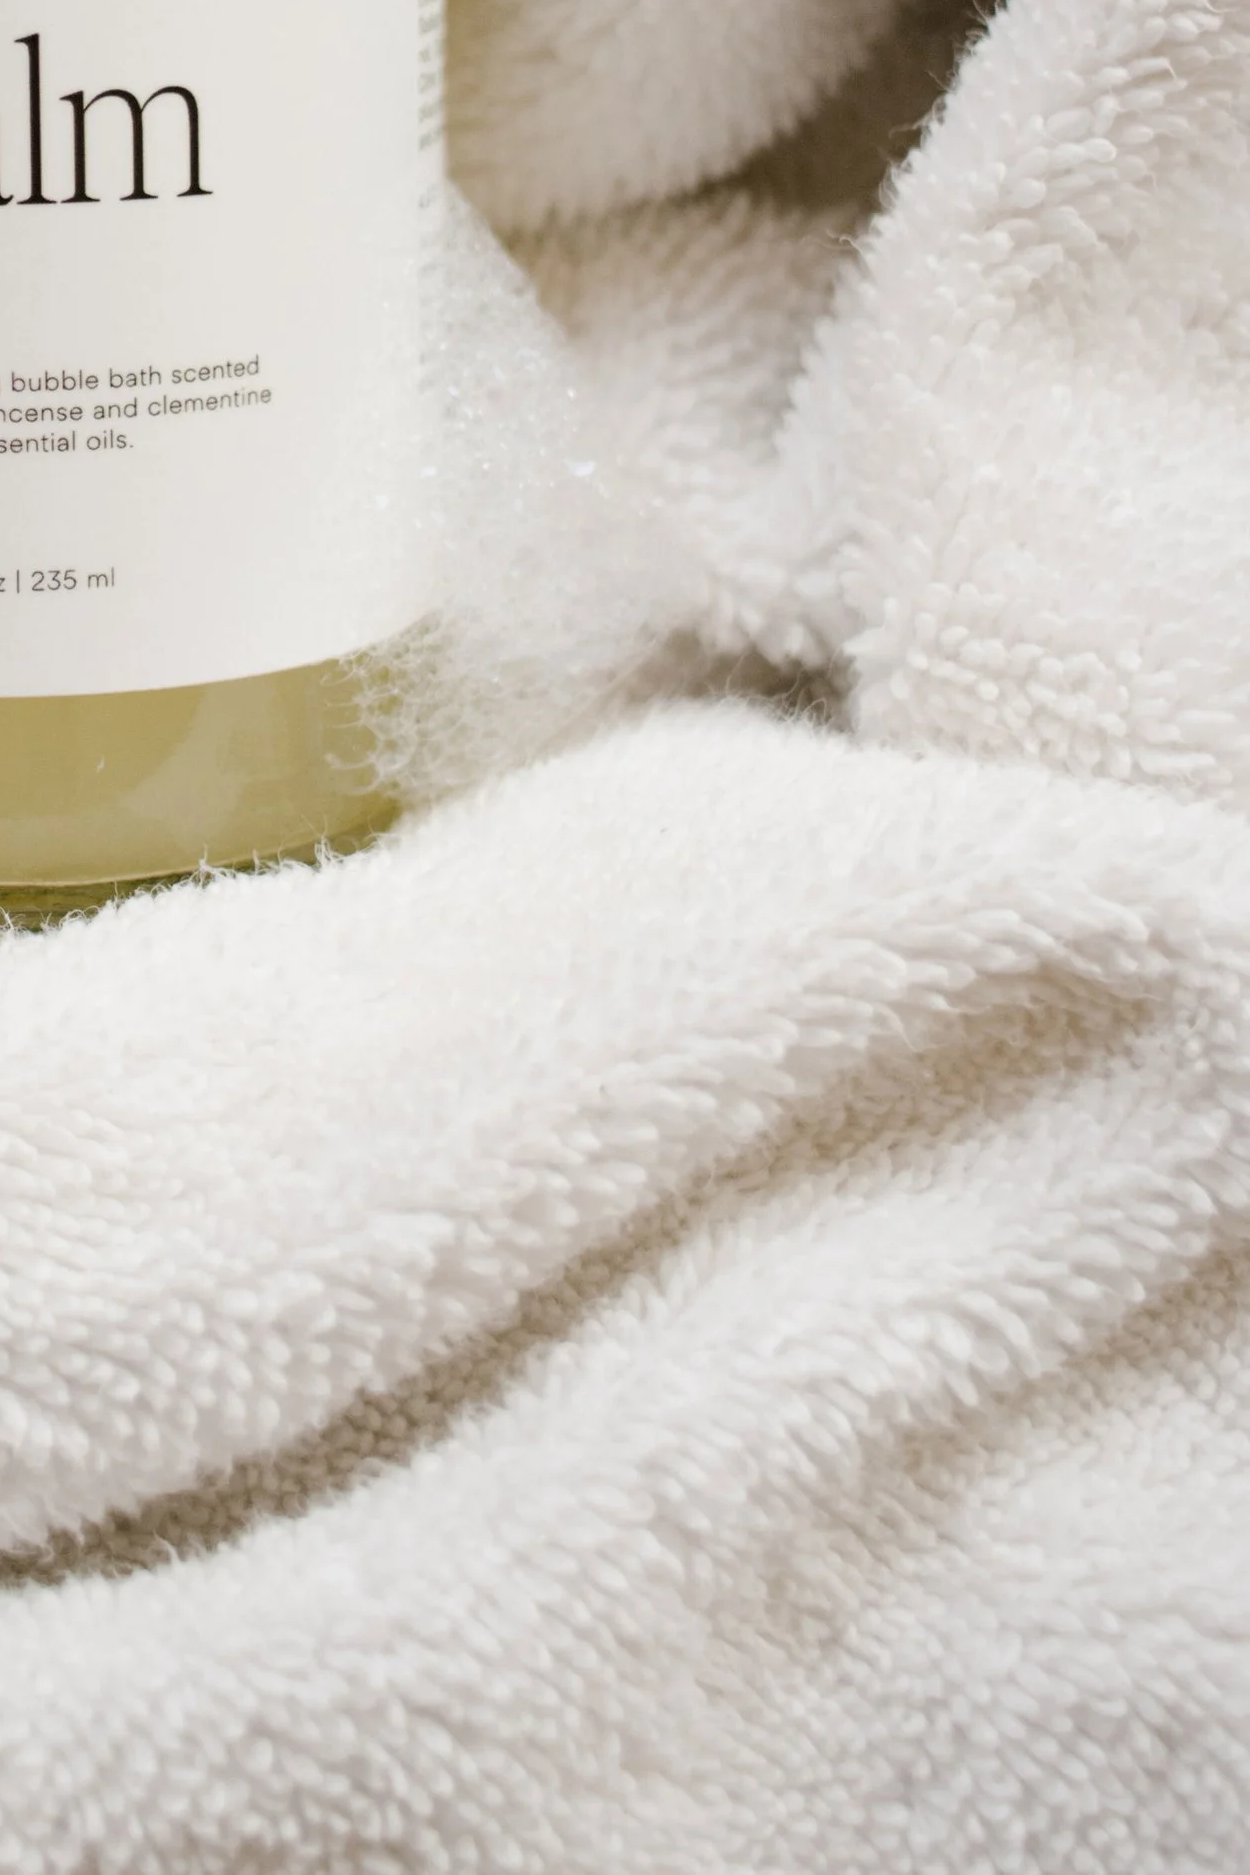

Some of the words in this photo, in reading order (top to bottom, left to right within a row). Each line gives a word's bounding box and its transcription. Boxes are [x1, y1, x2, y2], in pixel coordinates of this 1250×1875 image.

[11, 369, 99, 392] bubble
[109, 365, 161, 389] bath
[172, 354, 259, 384] scented
[93, 397, 138, 420] and
[147, 386, 272, 416] clementine
[86, 429, 133, 451] oils.
[31, 569, 77, 592] 235
[88, 567, 114, 588] ml
